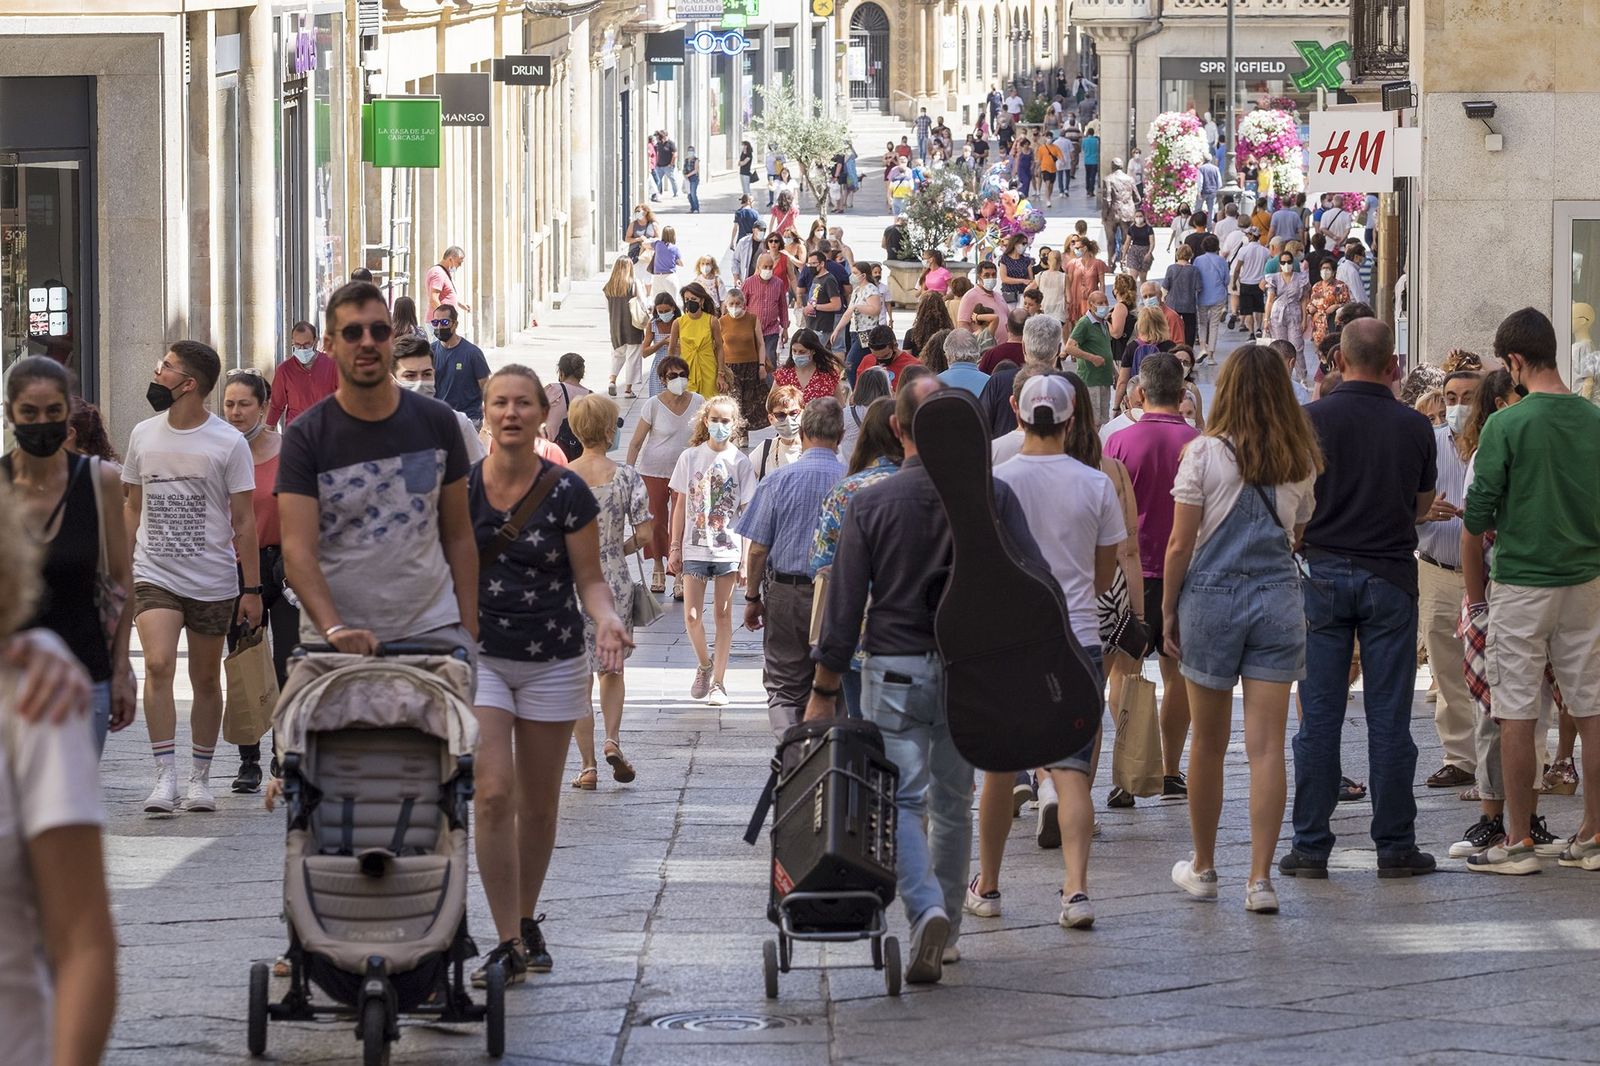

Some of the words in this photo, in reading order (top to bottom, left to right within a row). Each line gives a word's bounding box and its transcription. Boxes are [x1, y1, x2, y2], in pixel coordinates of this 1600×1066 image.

[512, 65, 544, 76] DRUNI
[1200, 61, 1286, 73] SPRNGFIELD
[441, 113, 485, 122] MANGO
[1317, 129, 1386, 176] H&M
